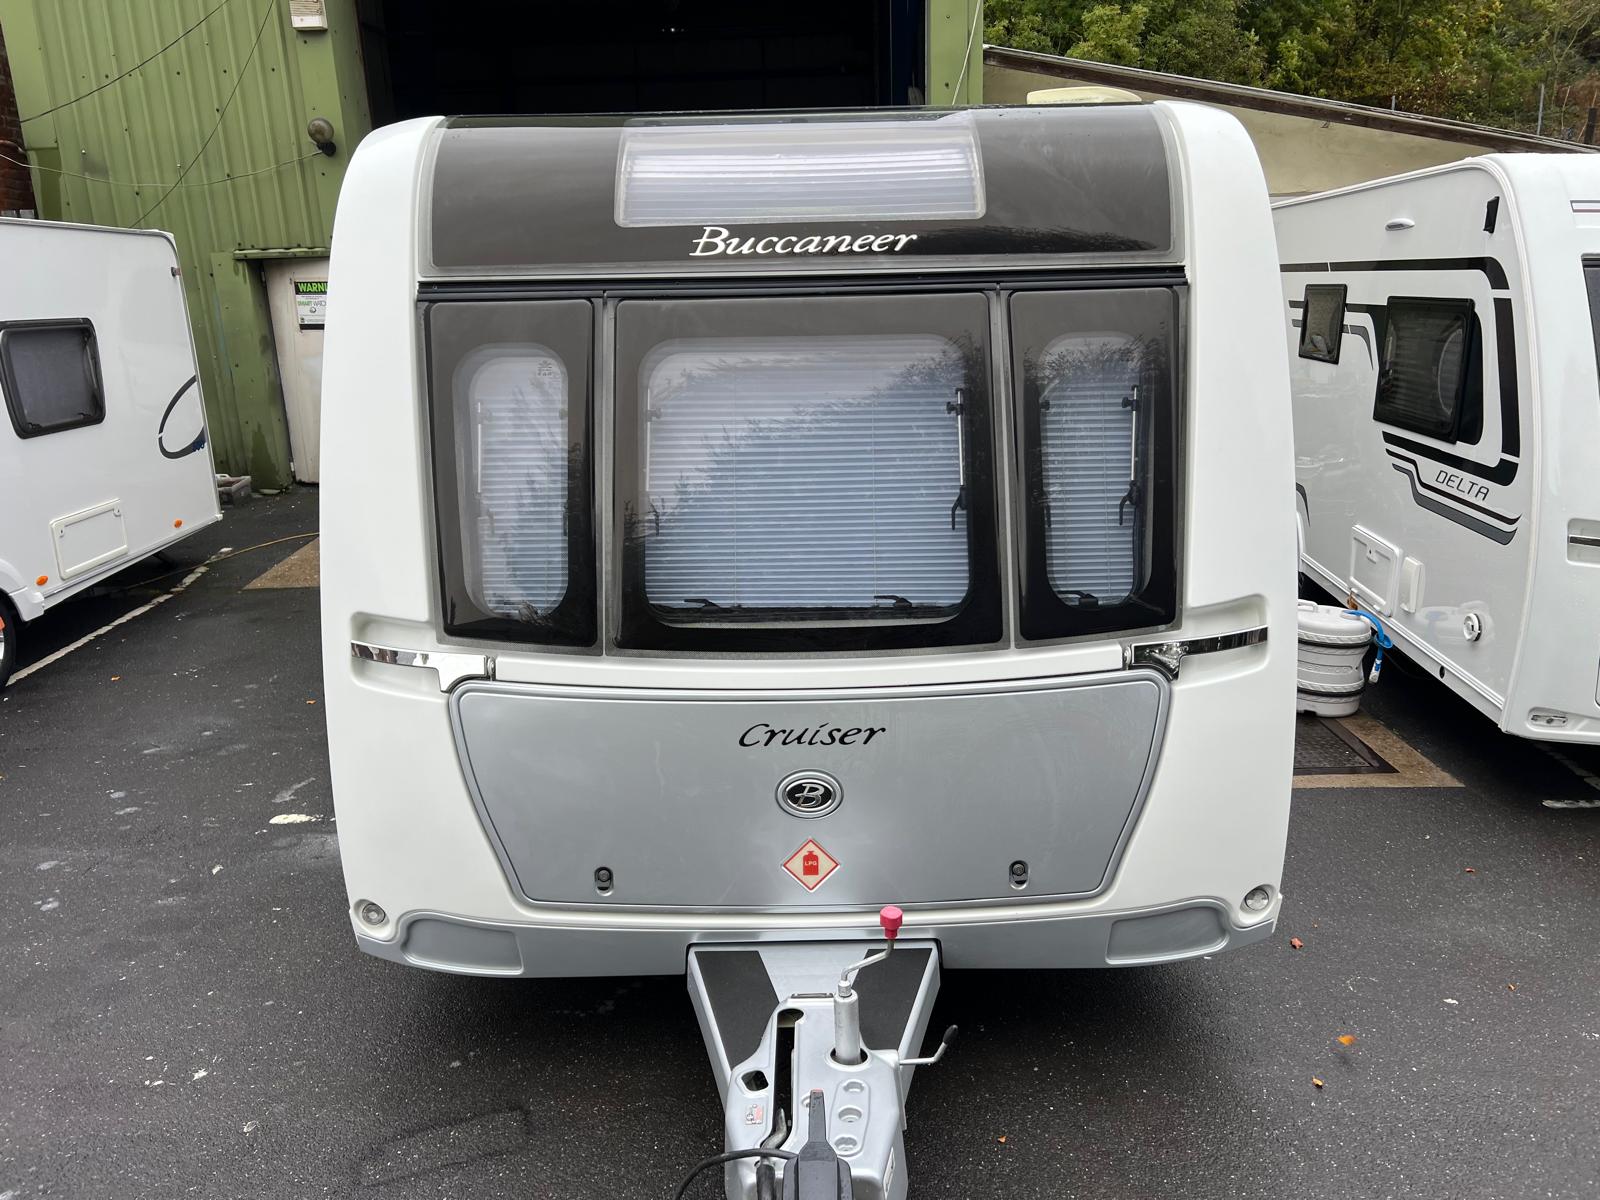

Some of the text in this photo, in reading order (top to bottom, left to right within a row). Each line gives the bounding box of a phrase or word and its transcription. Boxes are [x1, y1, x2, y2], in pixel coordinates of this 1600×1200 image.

[689, 226, 918, 256] Buccaneer
[297, 282, 328, 292] WARNI
[1435, 470, 1490, 501] DELTA
[738, 722, 886, 747] Cruiser
